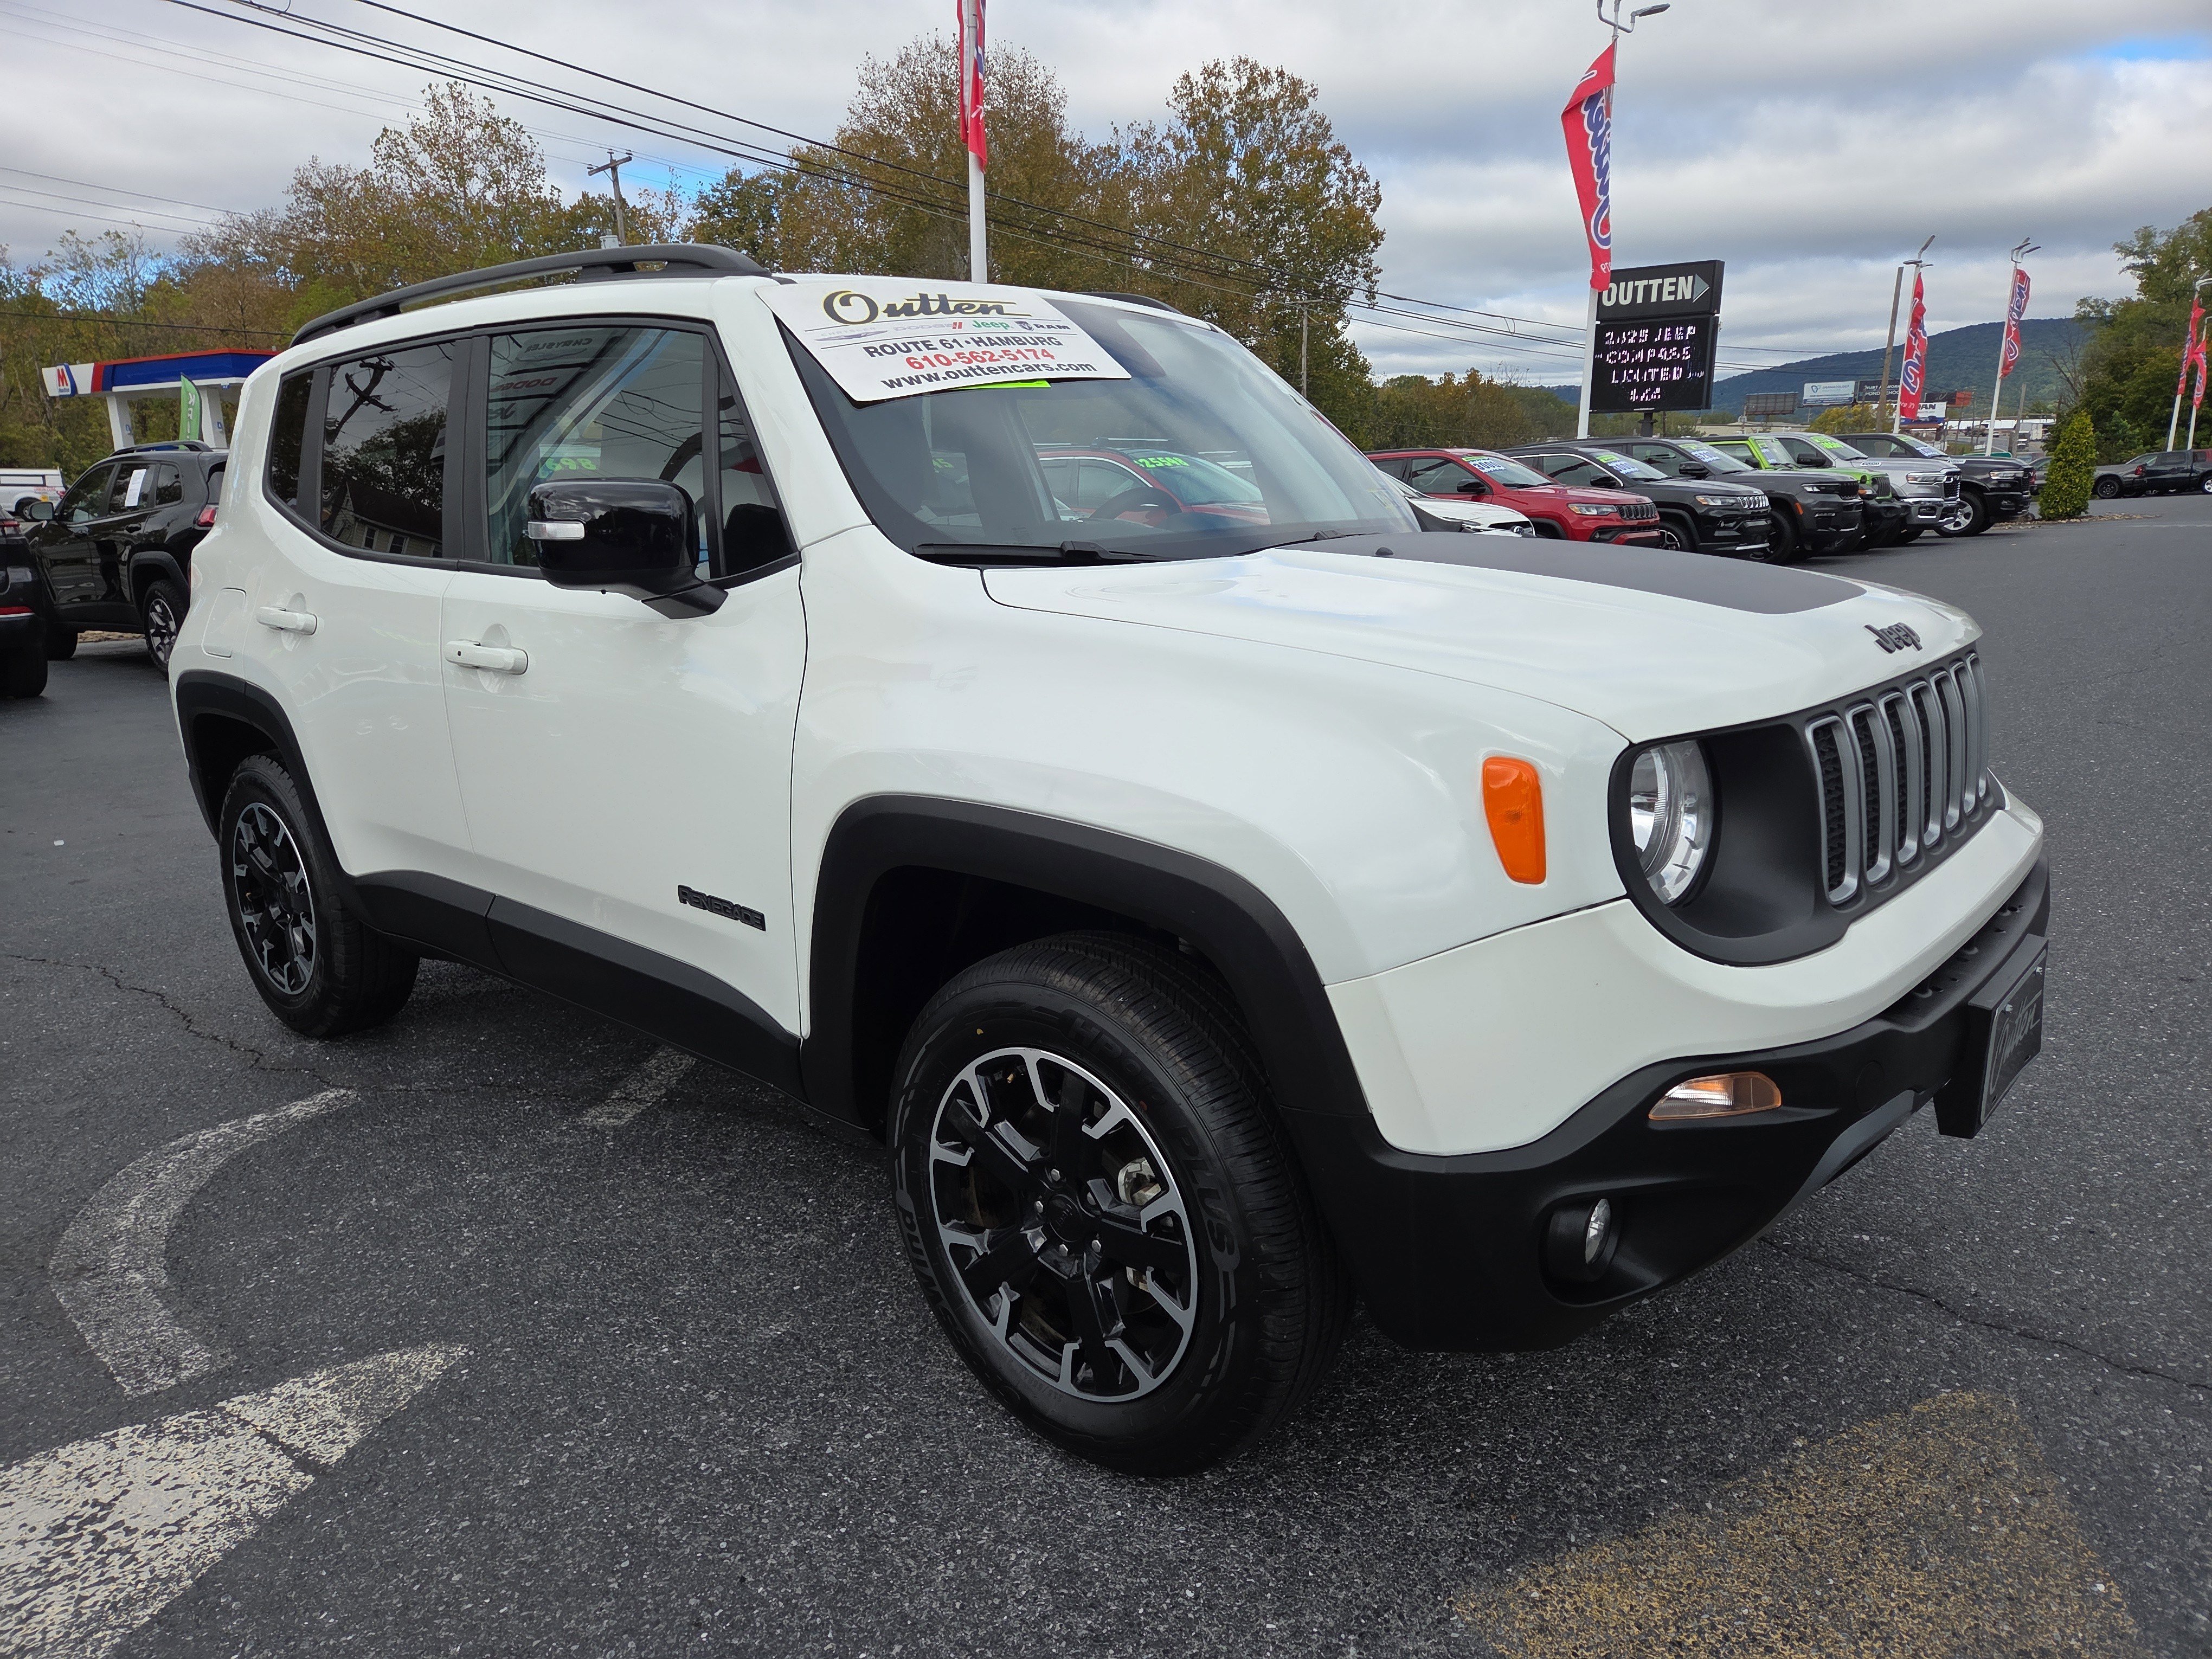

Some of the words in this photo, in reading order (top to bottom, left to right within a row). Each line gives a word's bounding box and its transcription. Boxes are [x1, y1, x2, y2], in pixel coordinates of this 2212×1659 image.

[1602, 275, 1693, 306] OUTTEN
[823, 290, 1032, 325] Outten
[972, 320, 1009, 330] Jeep
[863, 340, 939, 358] ROUTE
[906, 349, 1055, 370] 610-562-5174
[881, 362, 1097, 389] www.outtencars.com
[1864, 622, 1923, 654] Jeep
[678, 885, 766, 931] RENEGADE
[1171, 1124, 1236, 1256] PLUS
